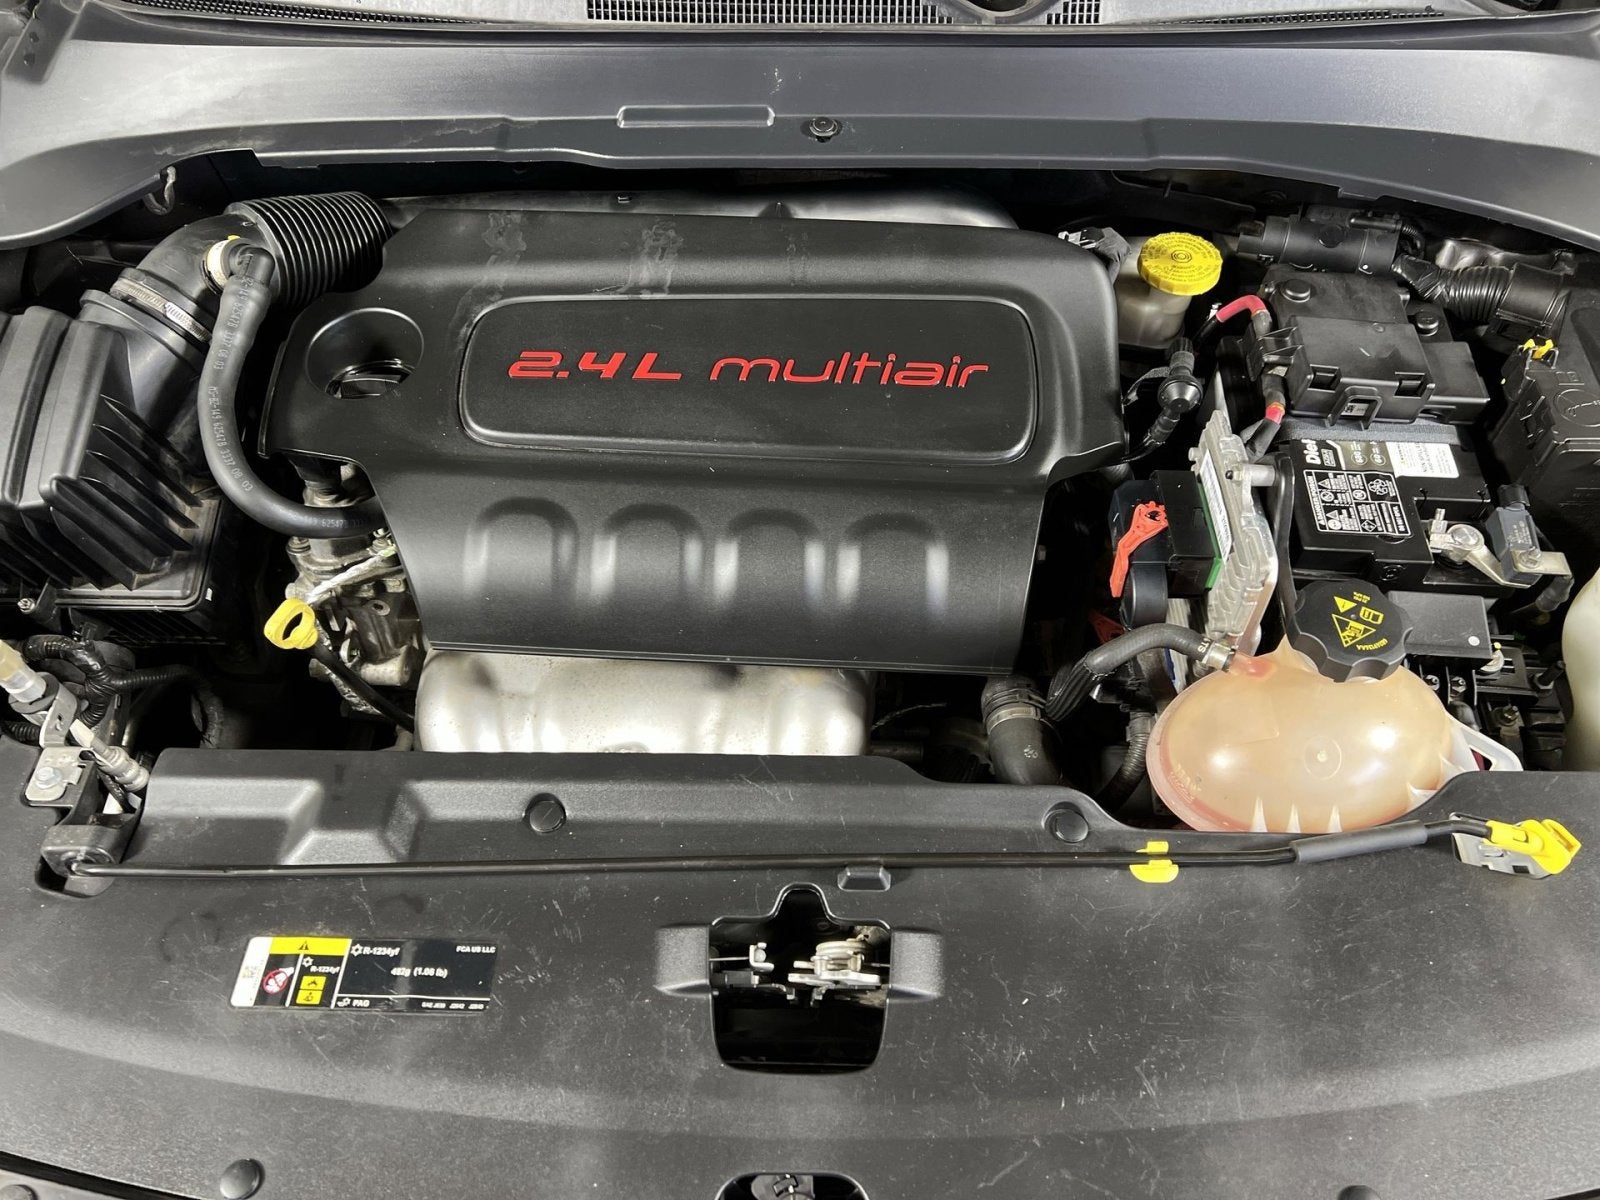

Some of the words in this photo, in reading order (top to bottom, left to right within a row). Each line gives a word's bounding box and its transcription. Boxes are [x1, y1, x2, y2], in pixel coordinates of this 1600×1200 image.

[508, 351, 682, 381] 2.4L
[710, 351, 990, 388] multiair
[455, 945, 470, 954] FCA
[482, 945, 496, 954] LLC
